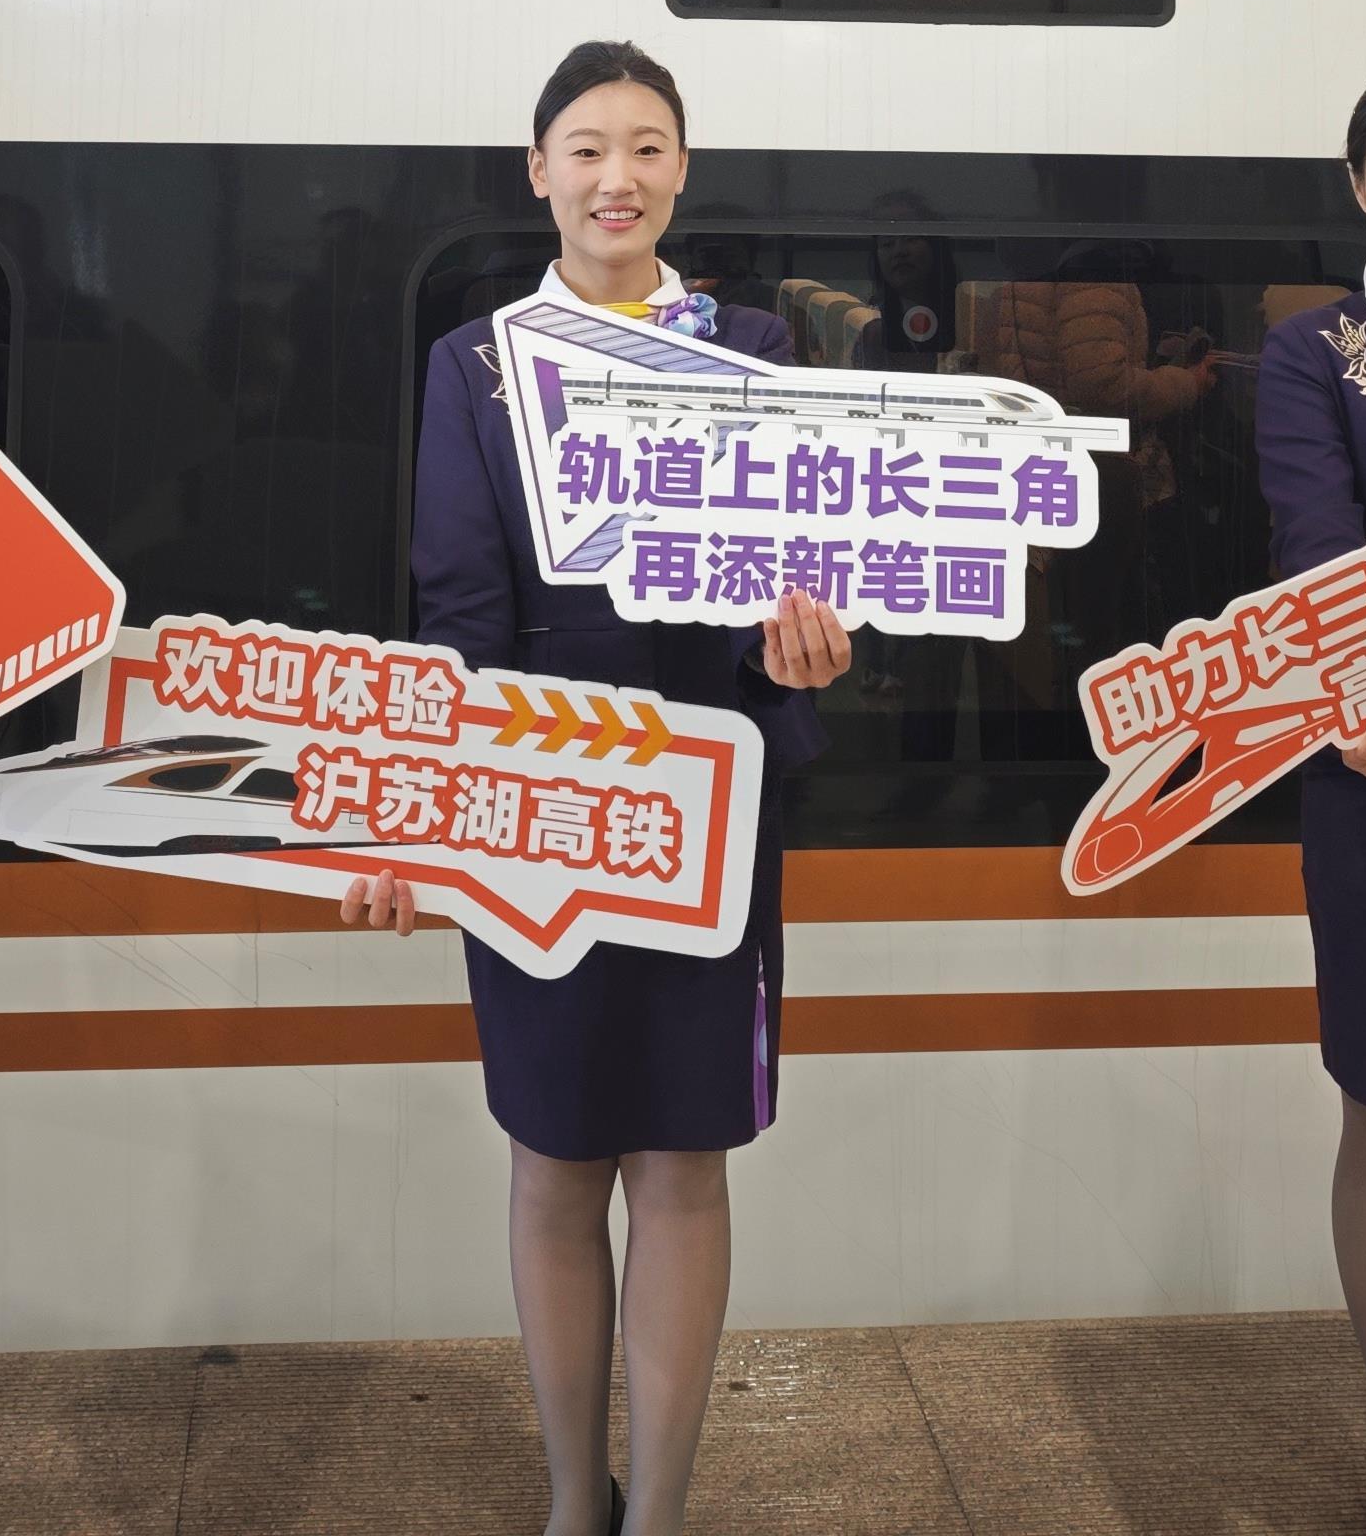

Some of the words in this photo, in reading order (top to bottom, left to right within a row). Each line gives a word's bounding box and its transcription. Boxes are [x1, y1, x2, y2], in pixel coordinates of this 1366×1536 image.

[557, 432, 1080, 528] 轨道上的长三角
[628, 530, 1007, 619] 再添新笔画
[161, 634, 457, 737] 欢迎体验
[298, 751, 681, 875] 沪苏湖高铁
